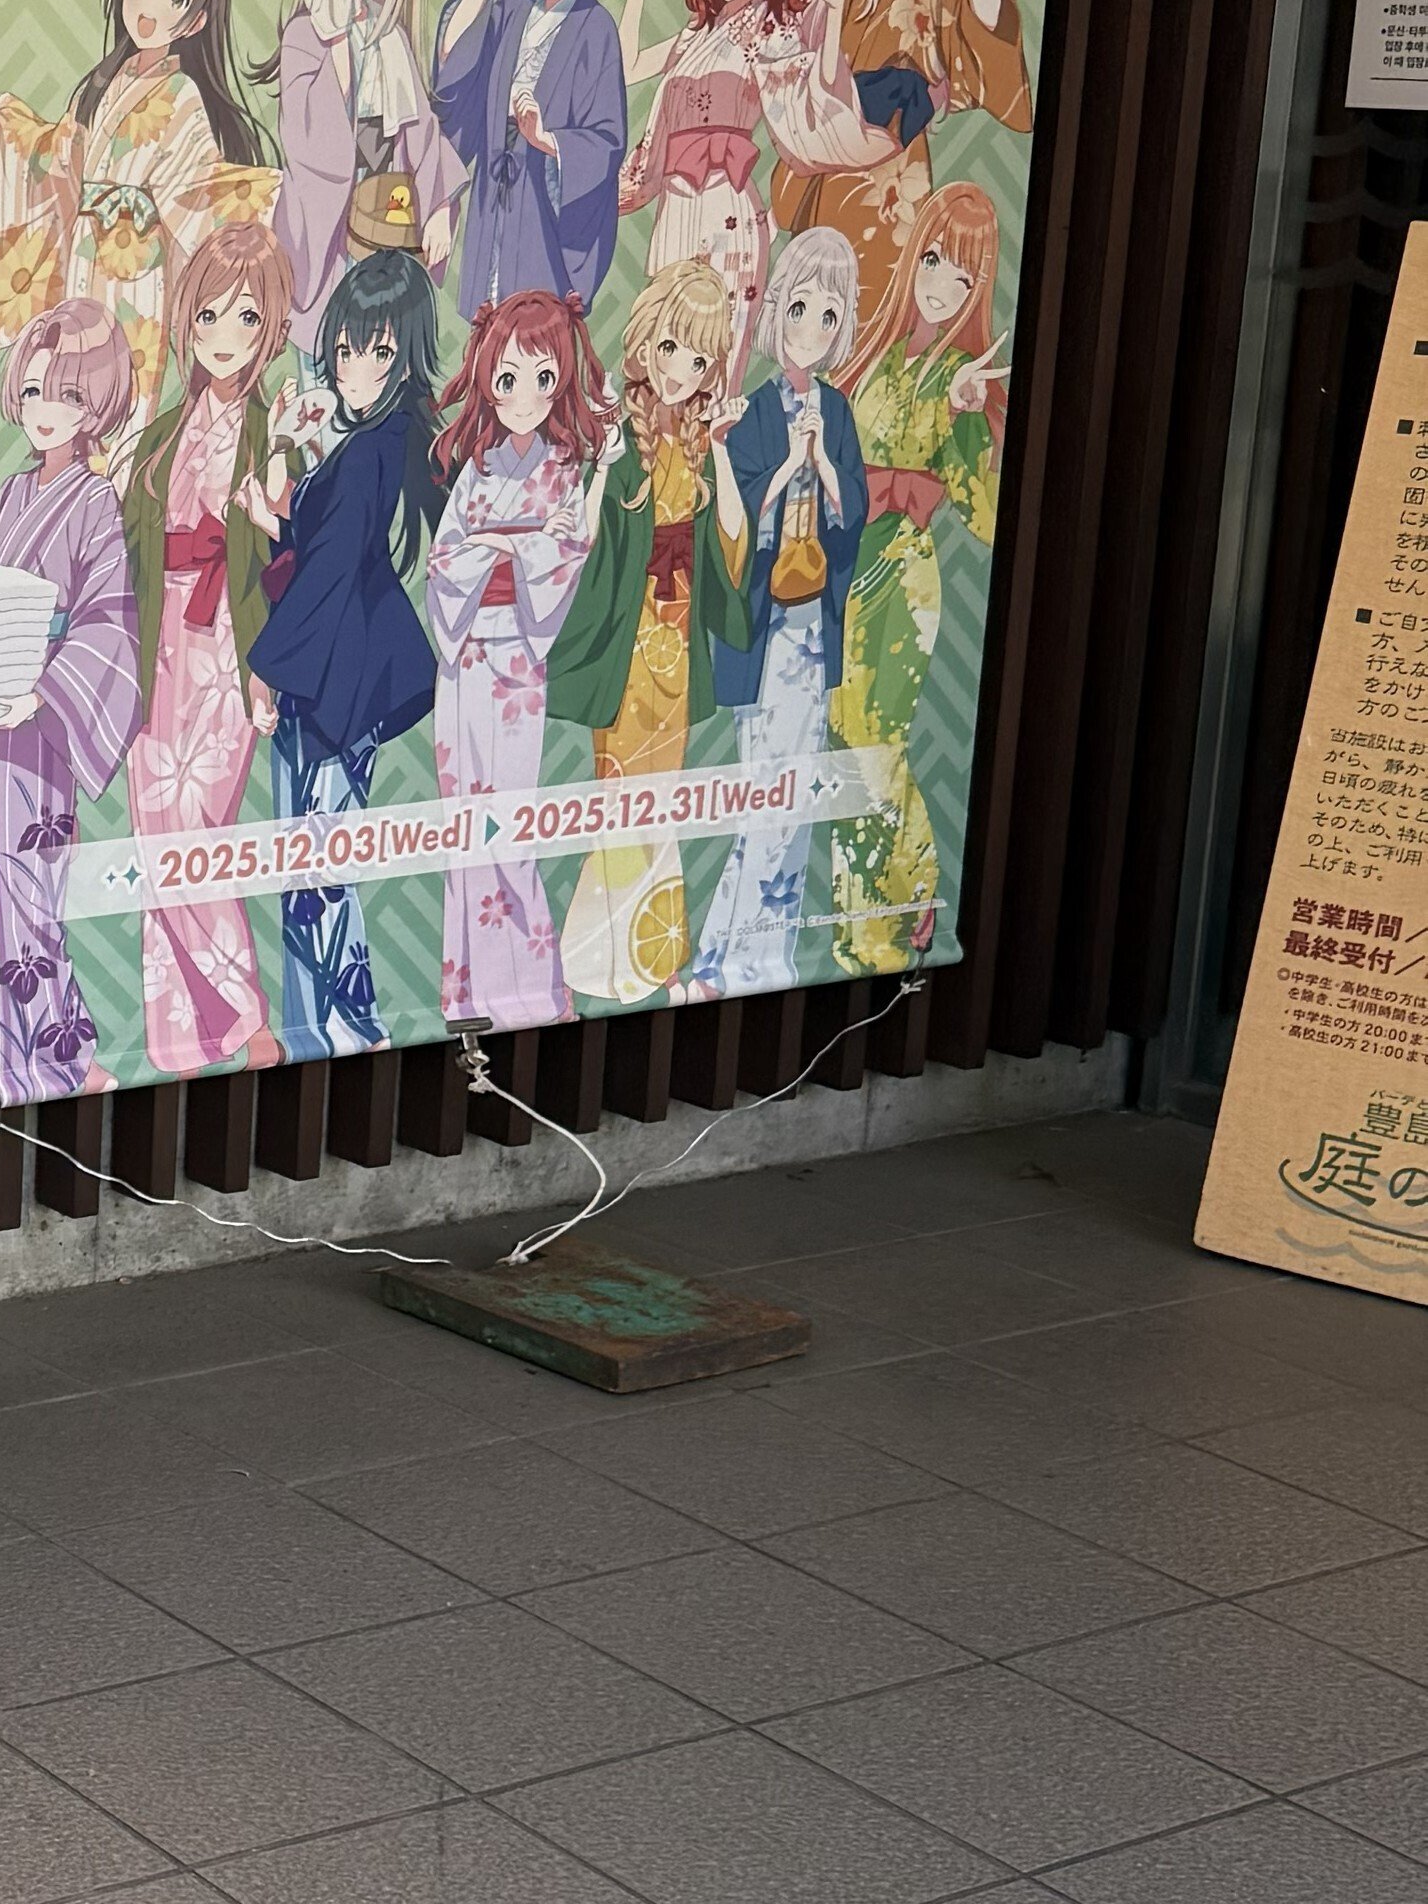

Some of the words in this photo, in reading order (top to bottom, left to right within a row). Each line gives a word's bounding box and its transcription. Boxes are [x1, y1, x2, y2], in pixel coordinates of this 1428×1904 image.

[1385, 577, 1425, 596] せん
[1364, 677, 1426, 700] をかけ
[1356, 699, 1428, 724] 方のご
[1331, 727, 1428, 756] 当施設はお
[1324, 750, 1428, 776] がら、静か
[156, 816, 471, 889] 2025.12.03[Wed]
[511, 768, 796, 844] 2025.12.31[Wed]
[1300, 853, 1384, 882] 上げます。
[1282, 930, 1428, 979] 最終受付／
